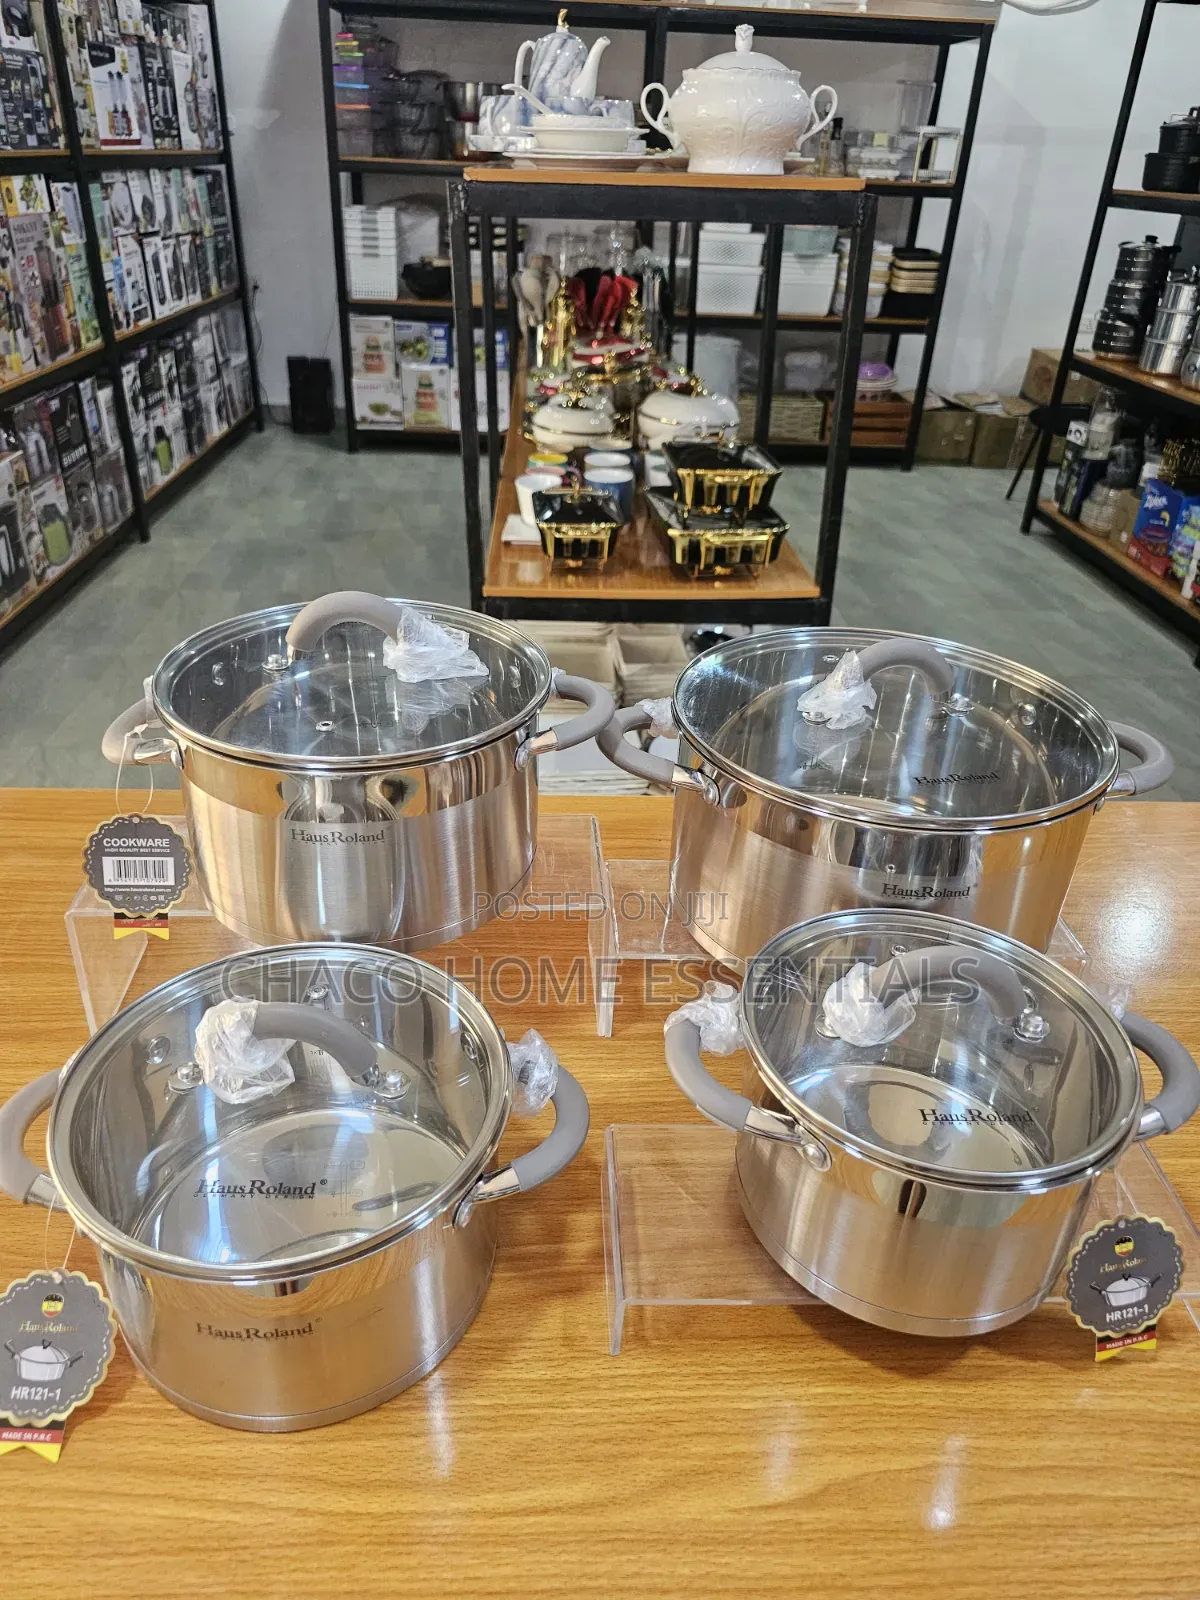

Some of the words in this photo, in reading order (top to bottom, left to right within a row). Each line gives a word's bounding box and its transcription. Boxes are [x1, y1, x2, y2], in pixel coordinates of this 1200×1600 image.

[103, 838, 170, 847] COOKWARE
[1105, 1303, 1149, 1323] HR121-1
[1106, 1341, 1124, 1349] MADE
[10, 1385, 62, 1401] HR121-1
[1, 1431, 22, 1440] MADE
[23, 1432, 33, 1440] IN
